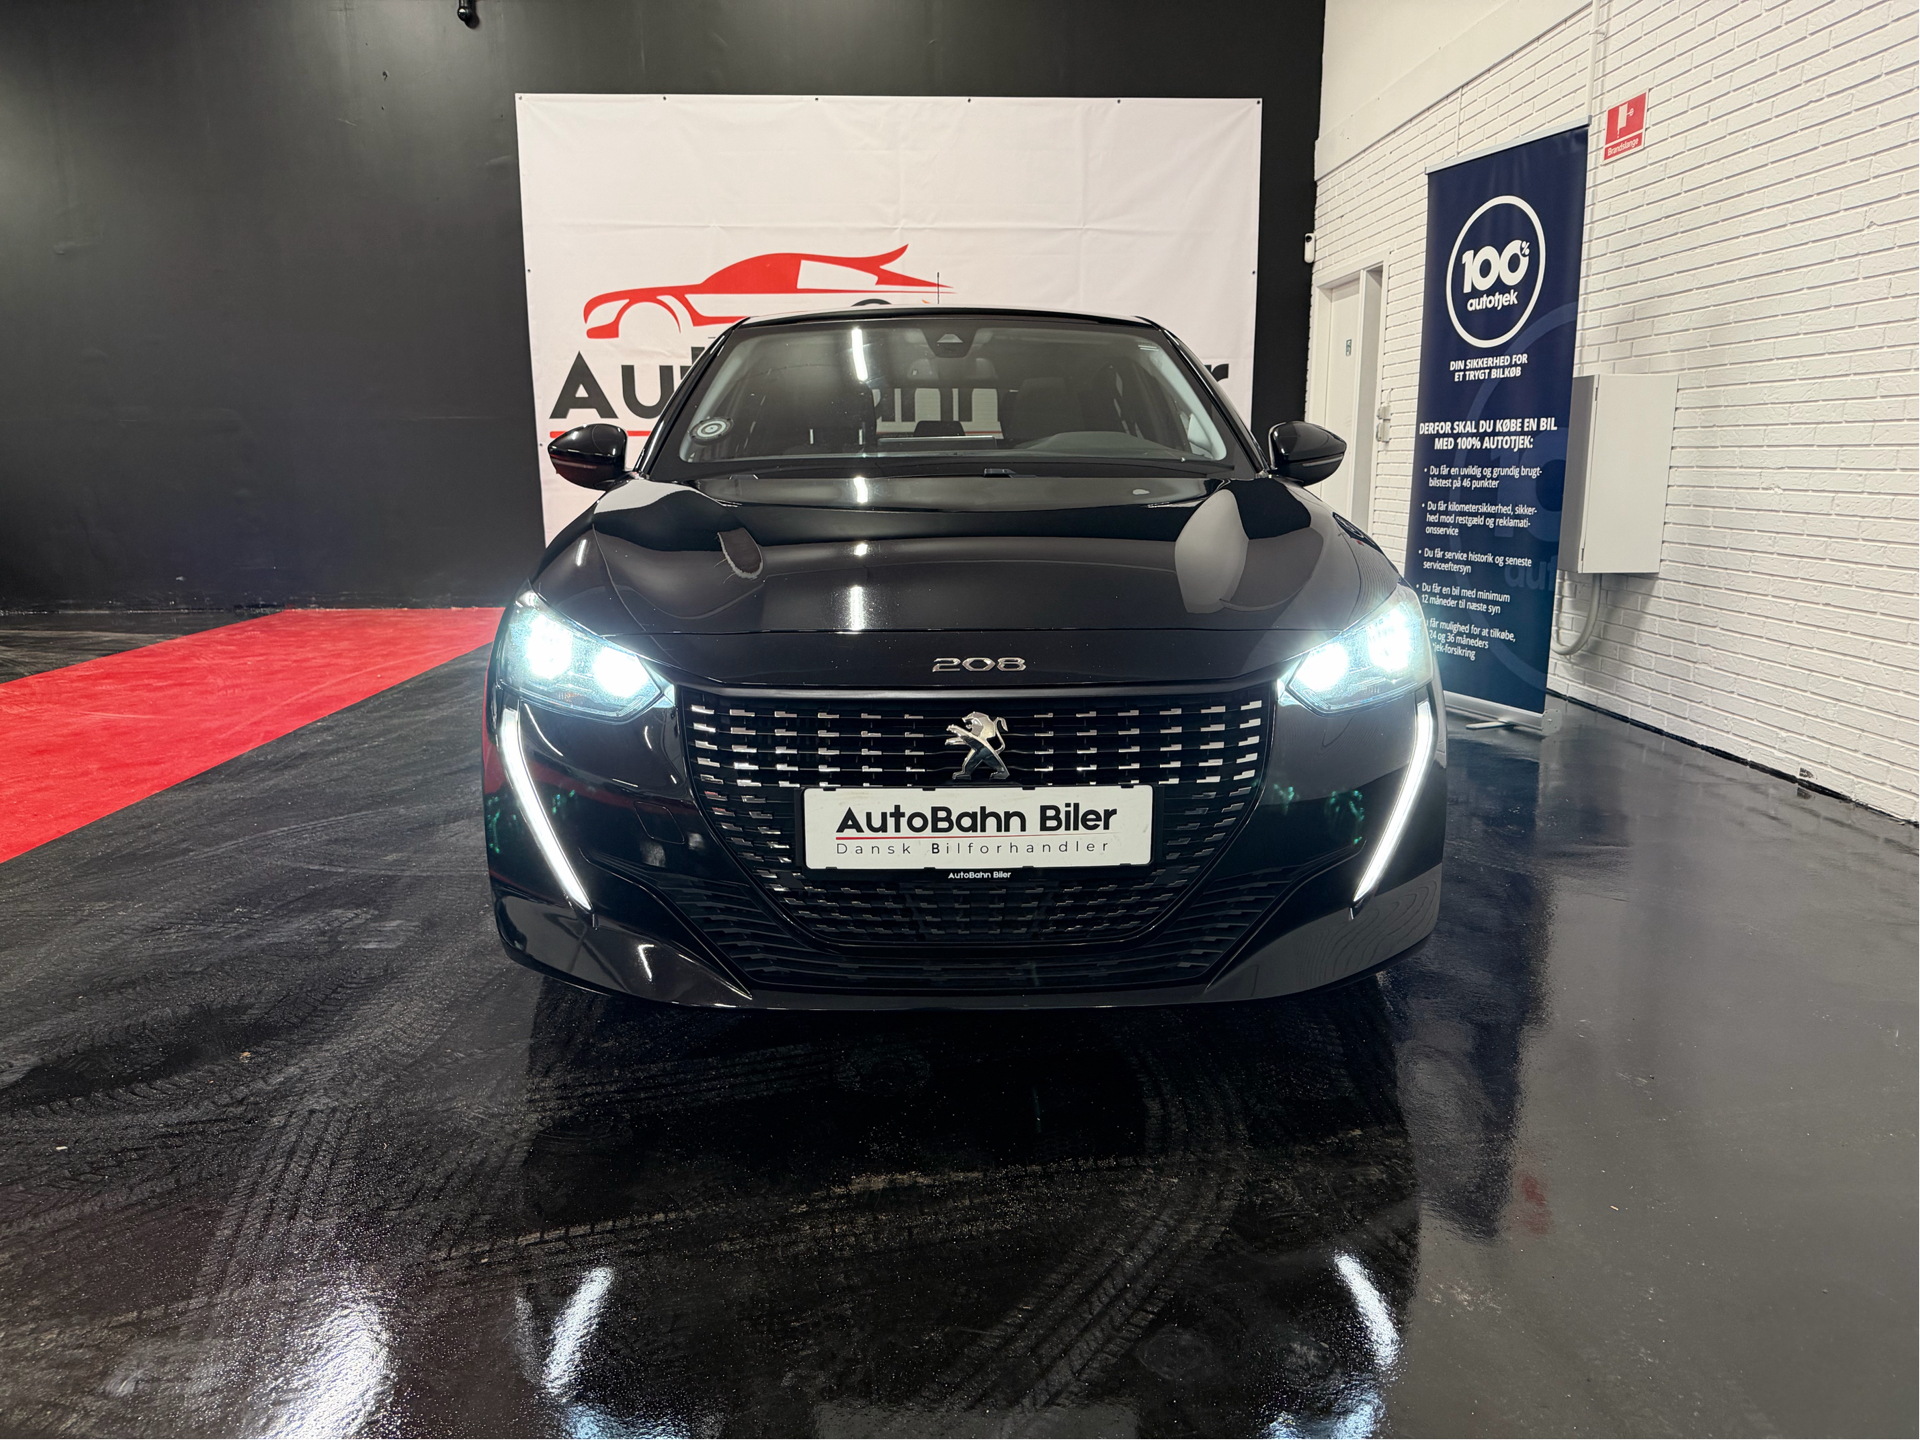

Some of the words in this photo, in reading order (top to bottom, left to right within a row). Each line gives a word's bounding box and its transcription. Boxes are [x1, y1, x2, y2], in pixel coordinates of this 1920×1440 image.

[1608, 138, 1639, 156] Brandslange
[1467, 289, 1518, 311] autotjek
[1450, 361, 1465, 371] DIN
[1466, 356, 1510, 369] SIKKERHED
[1512, 353, 1528, 365] FOR
[1454, 372, 1464, 382] ET
[1465, 369, 1490, 381] TRYGT
[1491, 366, 1521, 379] BILKØB
[1419, 422, 1451, 434] DERFOR
[1453, 421, 1477, 434] SKAL
[1479, 420, 1494, 432] DU
[1496, 419, 1522, 432] KØBE
[1524, 418, 1537, 431] EN
[1539, 417, 1558, 431] BIL
[1434, 438, 1455, 450] MED
[1457, 437, 1480, 449] 100%
[1482, 435, 1534, 452] AUTOTJEK:
[1429, 465, 1439, 475] Du
[1440, 464, 1450, 475] får
[1450, 467, 1459, 475] en
[1460, 465, 1482, 478] uvildig
[1482, 468, 1492, 478] og
[1492, 466, 1520, 479] grundig
[1521, 466, 1542, 479] brugt-
[1429, 477, 1452, 487] bilstest
[1452, 477, 1461, 490] på
[1462, 478, 1471, 486] 46
[1472, 478, 1500, 490] punkter
[1427, 501, 1437, 510] Du
[1438, 500, 1447, 511] får
[1448, 501, 1513, 515] kilometersikkerhed,
[1514, 505, 1537, 515] sikker-
[1426, 513, 1439, 522] hed
[1440, 514, 1455, 523] mod
[1455, 515, 1485, 527] restgæld
[1485, 518, 1494, 528] og
[1495, 517, 1531, 528] reklamati-
[1425, 526, 1459, 536] onsservice
[1424, 548, 1434, 557] Du
[1435, 548, 1444, 558] får
[1444, 551, 1468, 560] service
[1468, 551, 1493, 563] historik
[1495, 556, 1504, 567] og
[1505, 556, 1532, 567] seneste
[1423, 560, 1472, 575] serviceeftersyn
[1422, 582, 1431, 592] Du
[1432, 583, 1441, 593] får
[1442, 587, 1451, 595] en
[1451, 586, 1460, 596] bil
[1461, 588, 1476, 598] med
[1477, 590, 1511, 603] minimum
[1421, 594, 1429, 604] 12
[1429, 595, 1458, 608] måneder
[1466, 602, 1487, 612] næste
[1488, 605, 1501, 616] syn
[1429, 618, 1439, 628] får
[1440, 621, 1470, 633] mulighed
[1471, 624, 1480, 635] for
[1481, 628, 1489, 637] at
[1490, 628, 1516, 642] tilkøbe,
[1437, 633, 1446, 643] og
[1446, 633, 1455, 642] 36
[1456, 634, 1489, 649] måneders
[932, 657, 1026, 672] 208
[836, 805, 1026, 833] AutoBahn
[1040, 803, 1117, 831] Biler
[836, 843, 911, 855] Dansk
[931, 840, 1109, 855] Bilforhandler
[948, 871, 991, 879] AutoBahn
[993, 870, 1012, 878] Biler
